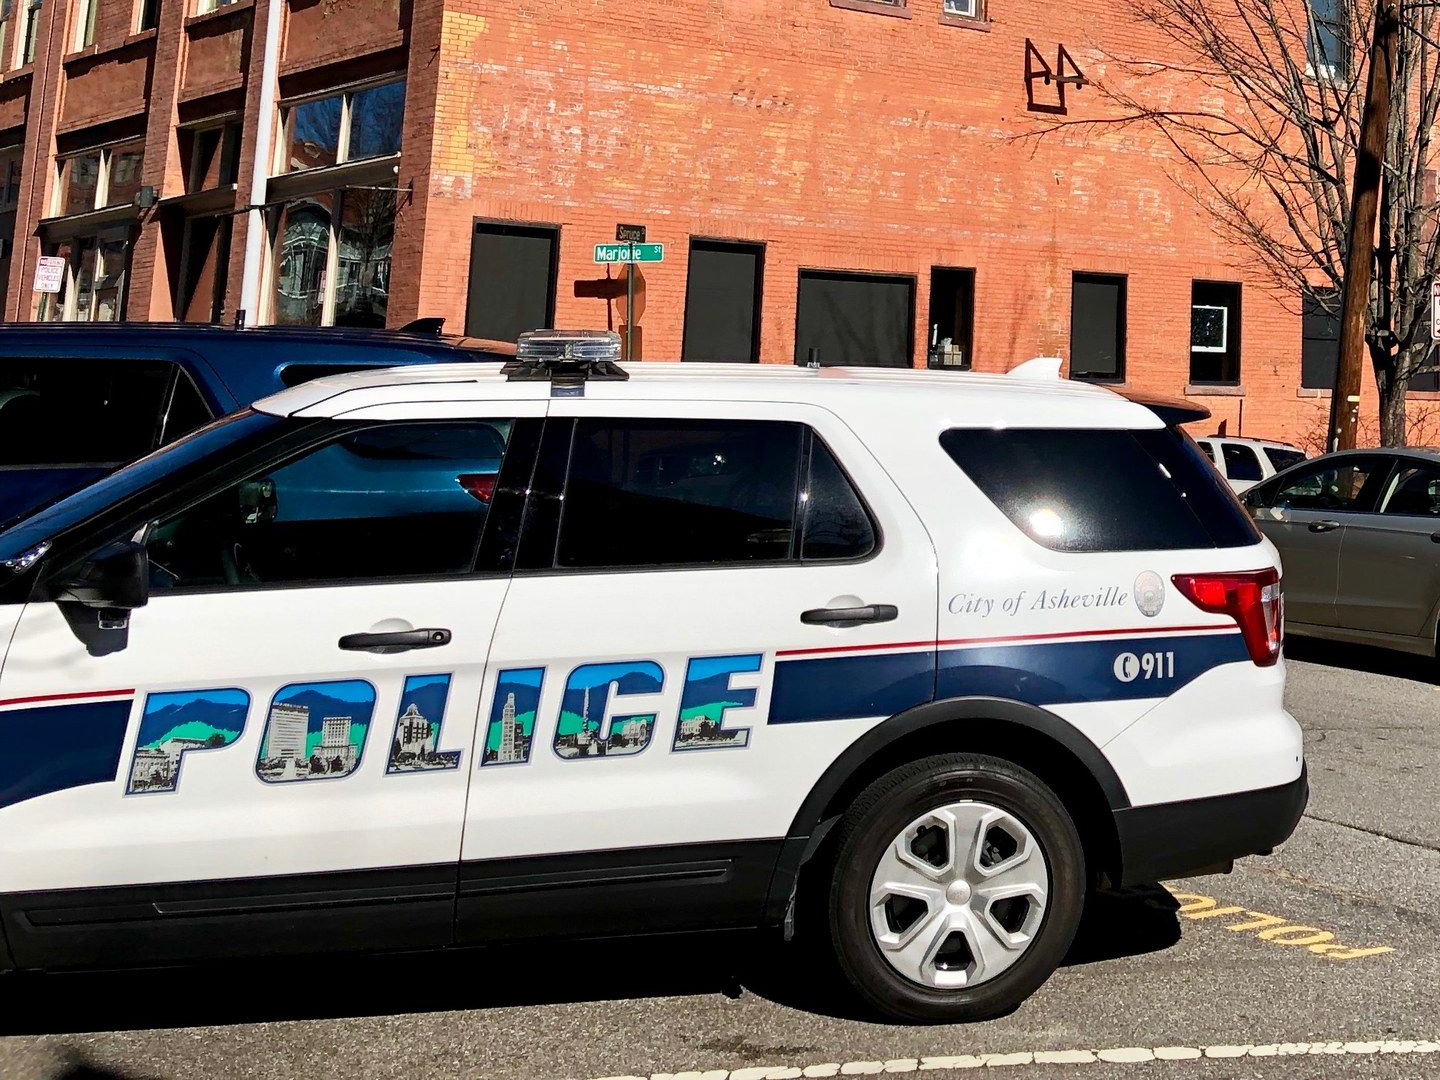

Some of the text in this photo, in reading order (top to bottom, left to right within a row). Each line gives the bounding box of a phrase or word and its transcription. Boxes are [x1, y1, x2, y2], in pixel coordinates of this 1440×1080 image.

[948, 586, 1128, 618] City of Asheville
[1141, 651, 1175, 681] 911
[121, 651, 766, 798] POLICE
